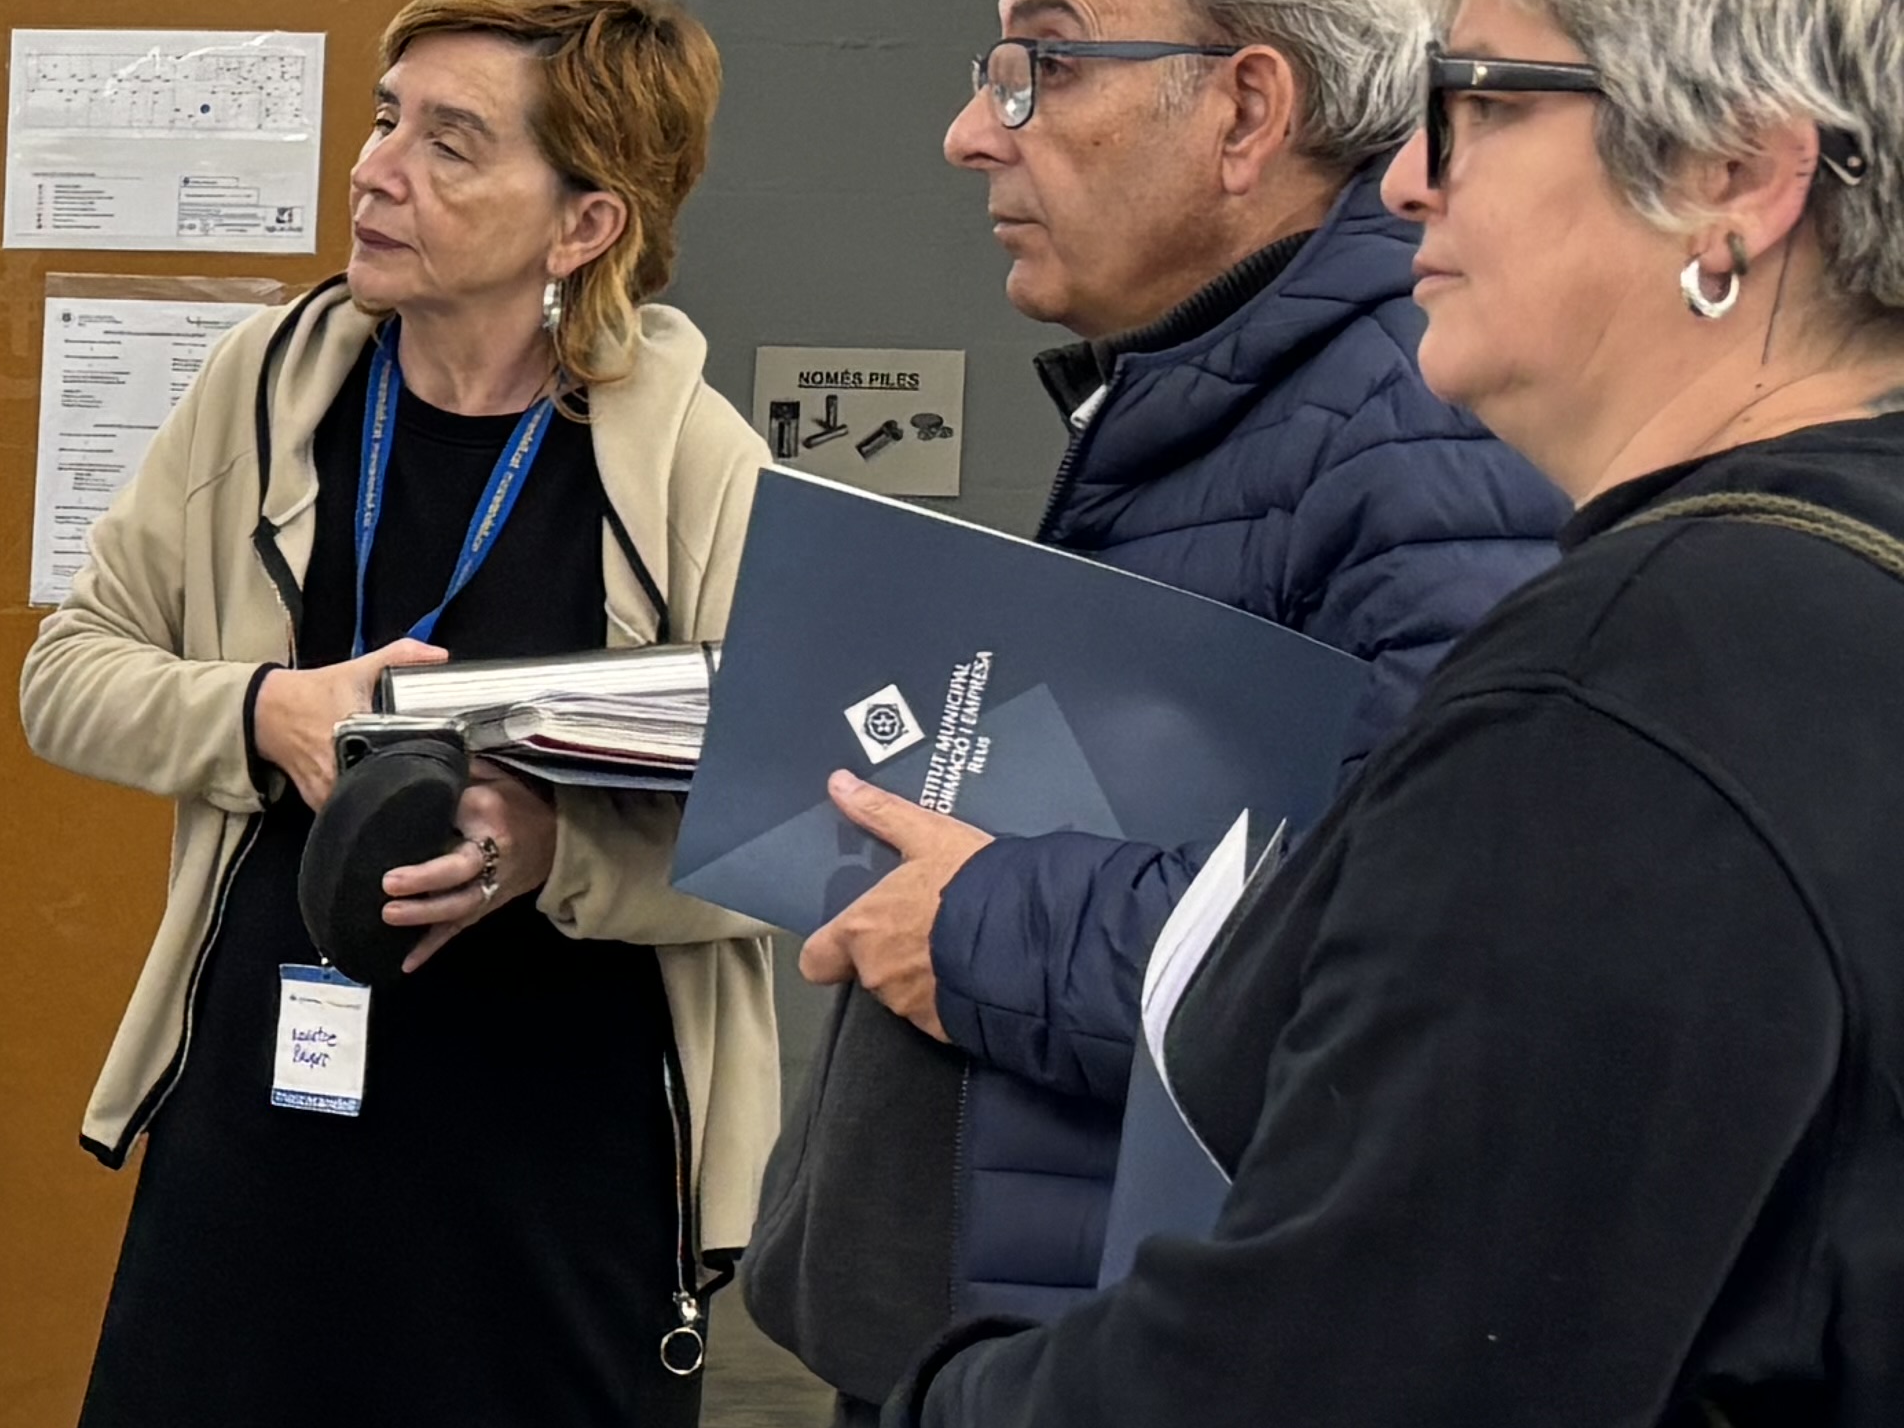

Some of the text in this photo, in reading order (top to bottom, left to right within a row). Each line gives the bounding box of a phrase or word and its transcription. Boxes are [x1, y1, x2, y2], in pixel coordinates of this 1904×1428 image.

[798, 369, 920, 387] NOMÉS PILES
[920, 663, 971, 809] STITUT MUNICIPAL
[936, 737, 970, 815] ORMACIÓ
[960, 651, 993, 725] EMPRESA
